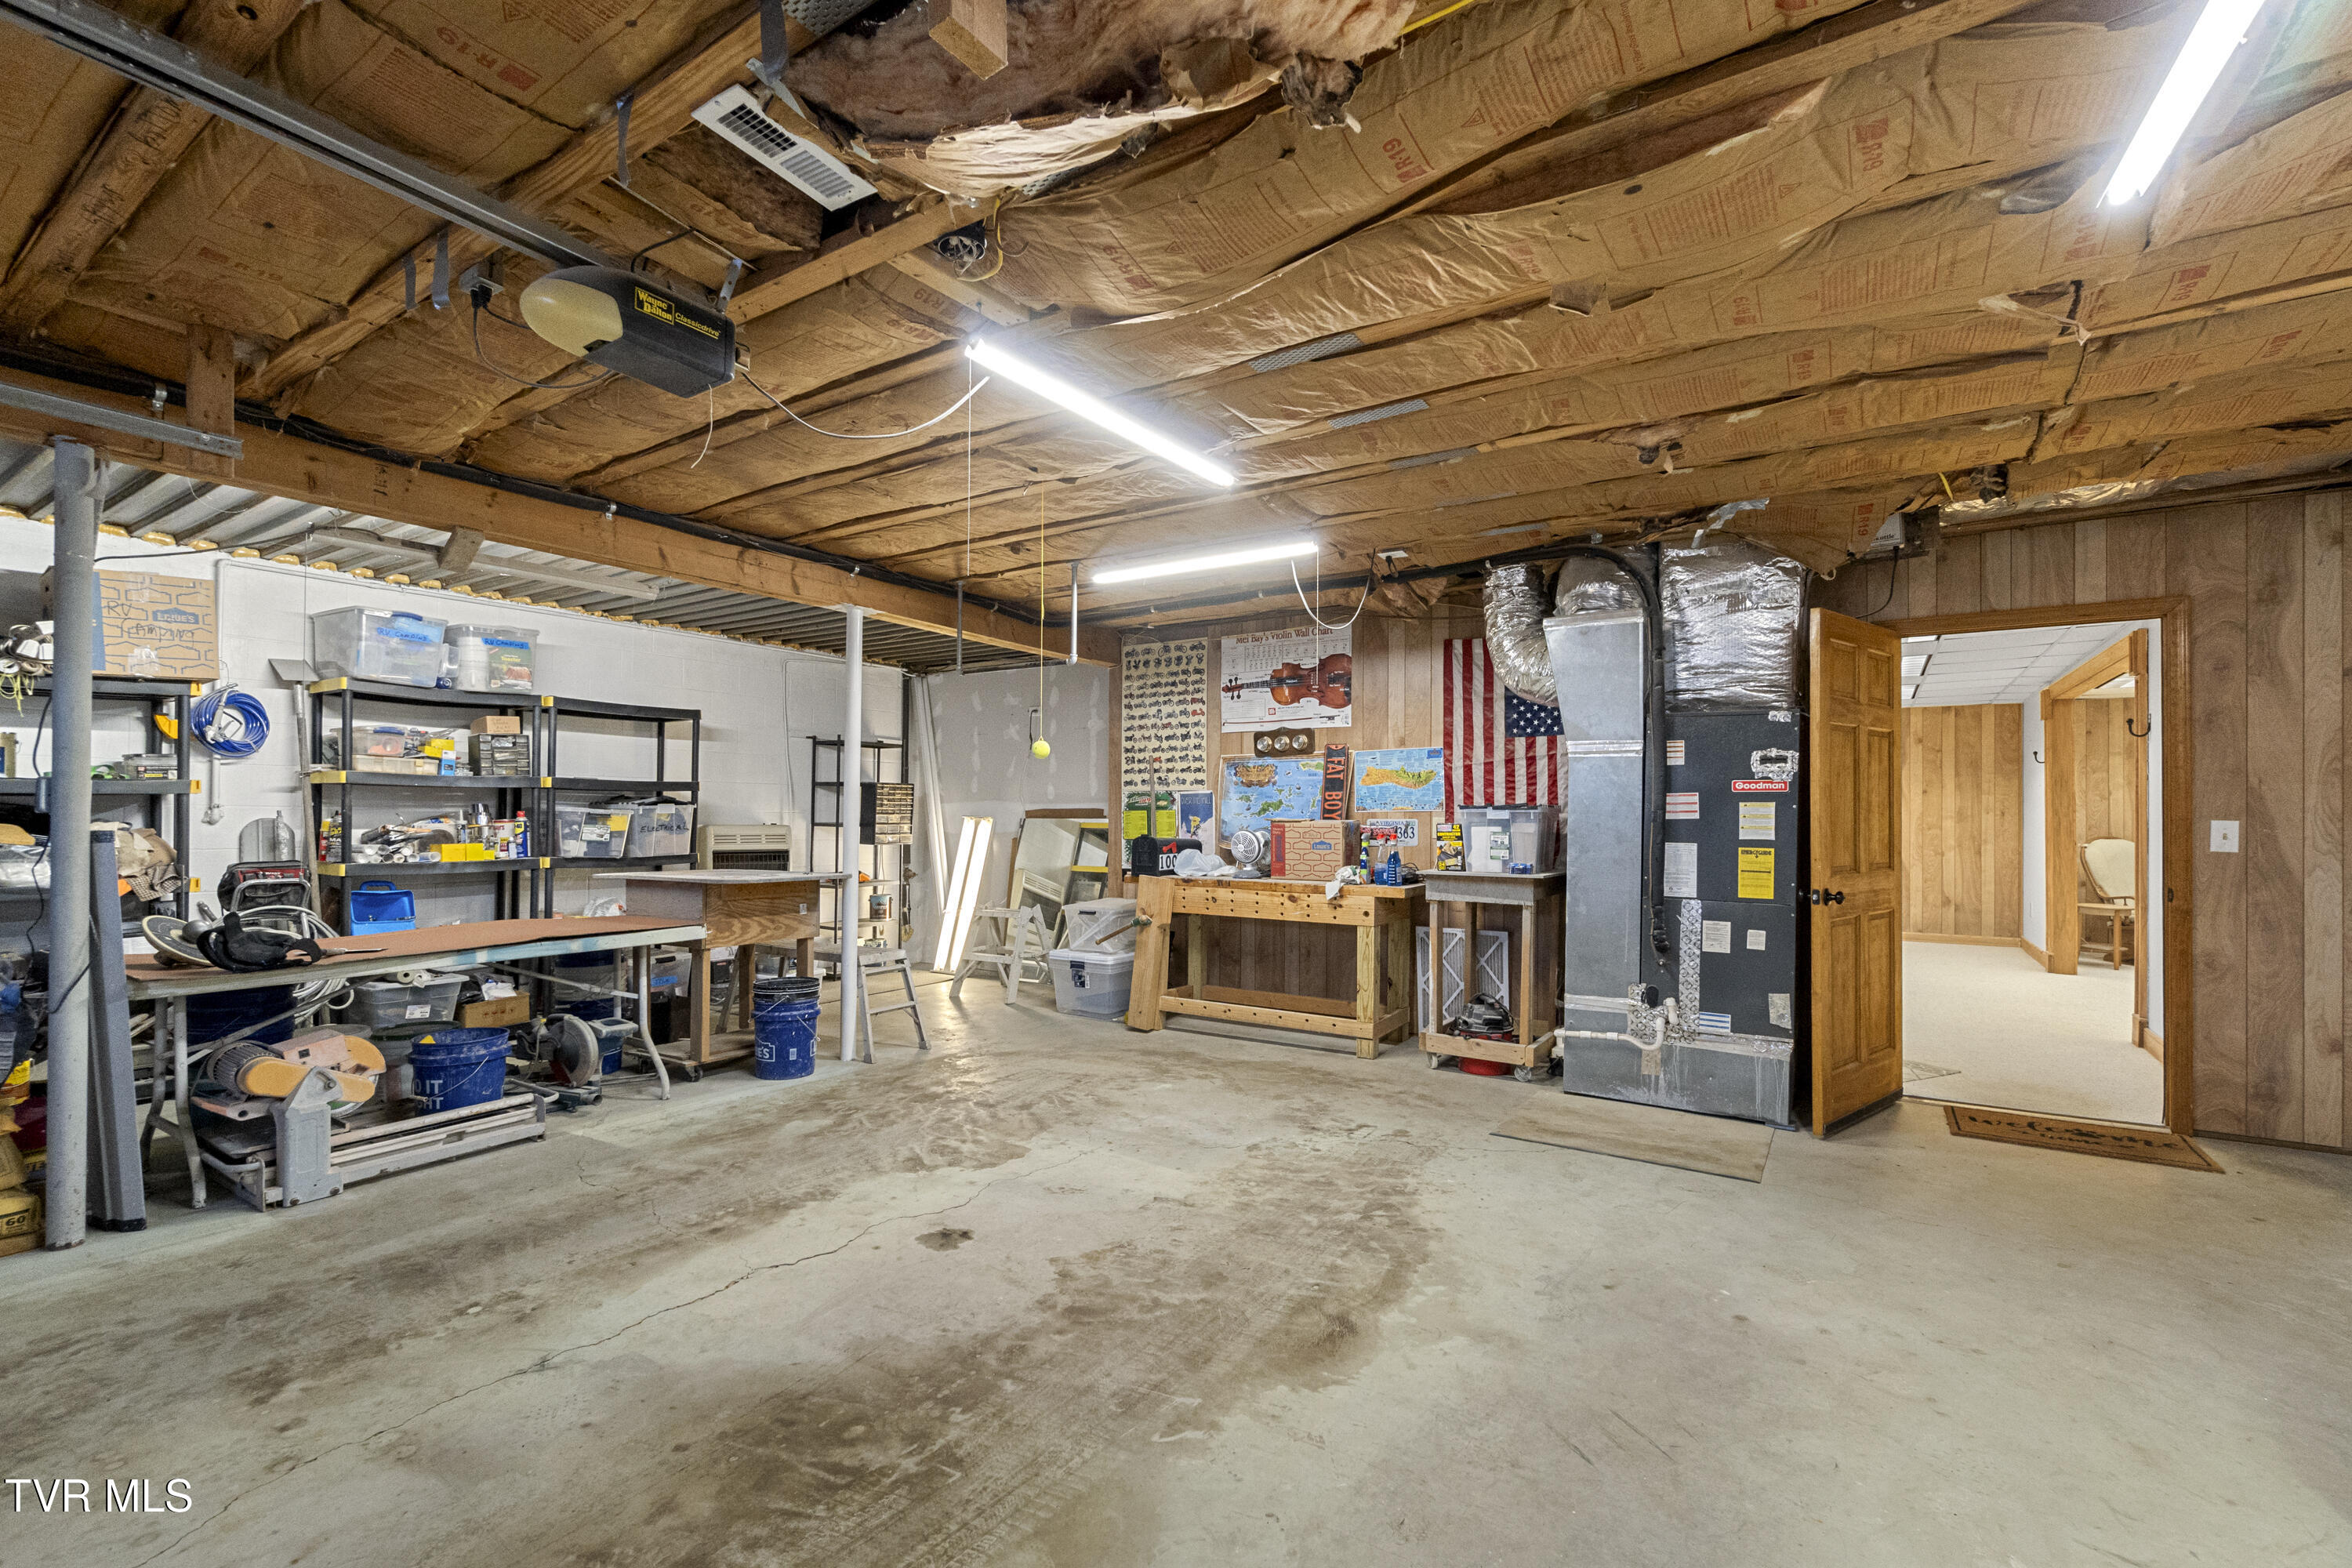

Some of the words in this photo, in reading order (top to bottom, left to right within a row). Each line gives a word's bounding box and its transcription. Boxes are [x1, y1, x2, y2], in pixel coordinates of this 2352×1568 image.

[637, 289, 668, 310] Wayne
[643, 302, 673, 321] Dalton
[675, 312, 720, 337] Classicdrive
[107, 601, 132, 617] RV
[1294, 627, 1310, 637] Wall
[1312, 626, 1334, 636] Chart
[1326, 757, 1345, 780] FAT
[1735, 782, 1786, 790] Goodman
[1323, 792, 1343, 820] BOY
[426, 1080, 444, 1094] IT
[5, 1214, 27, 1228] 60
